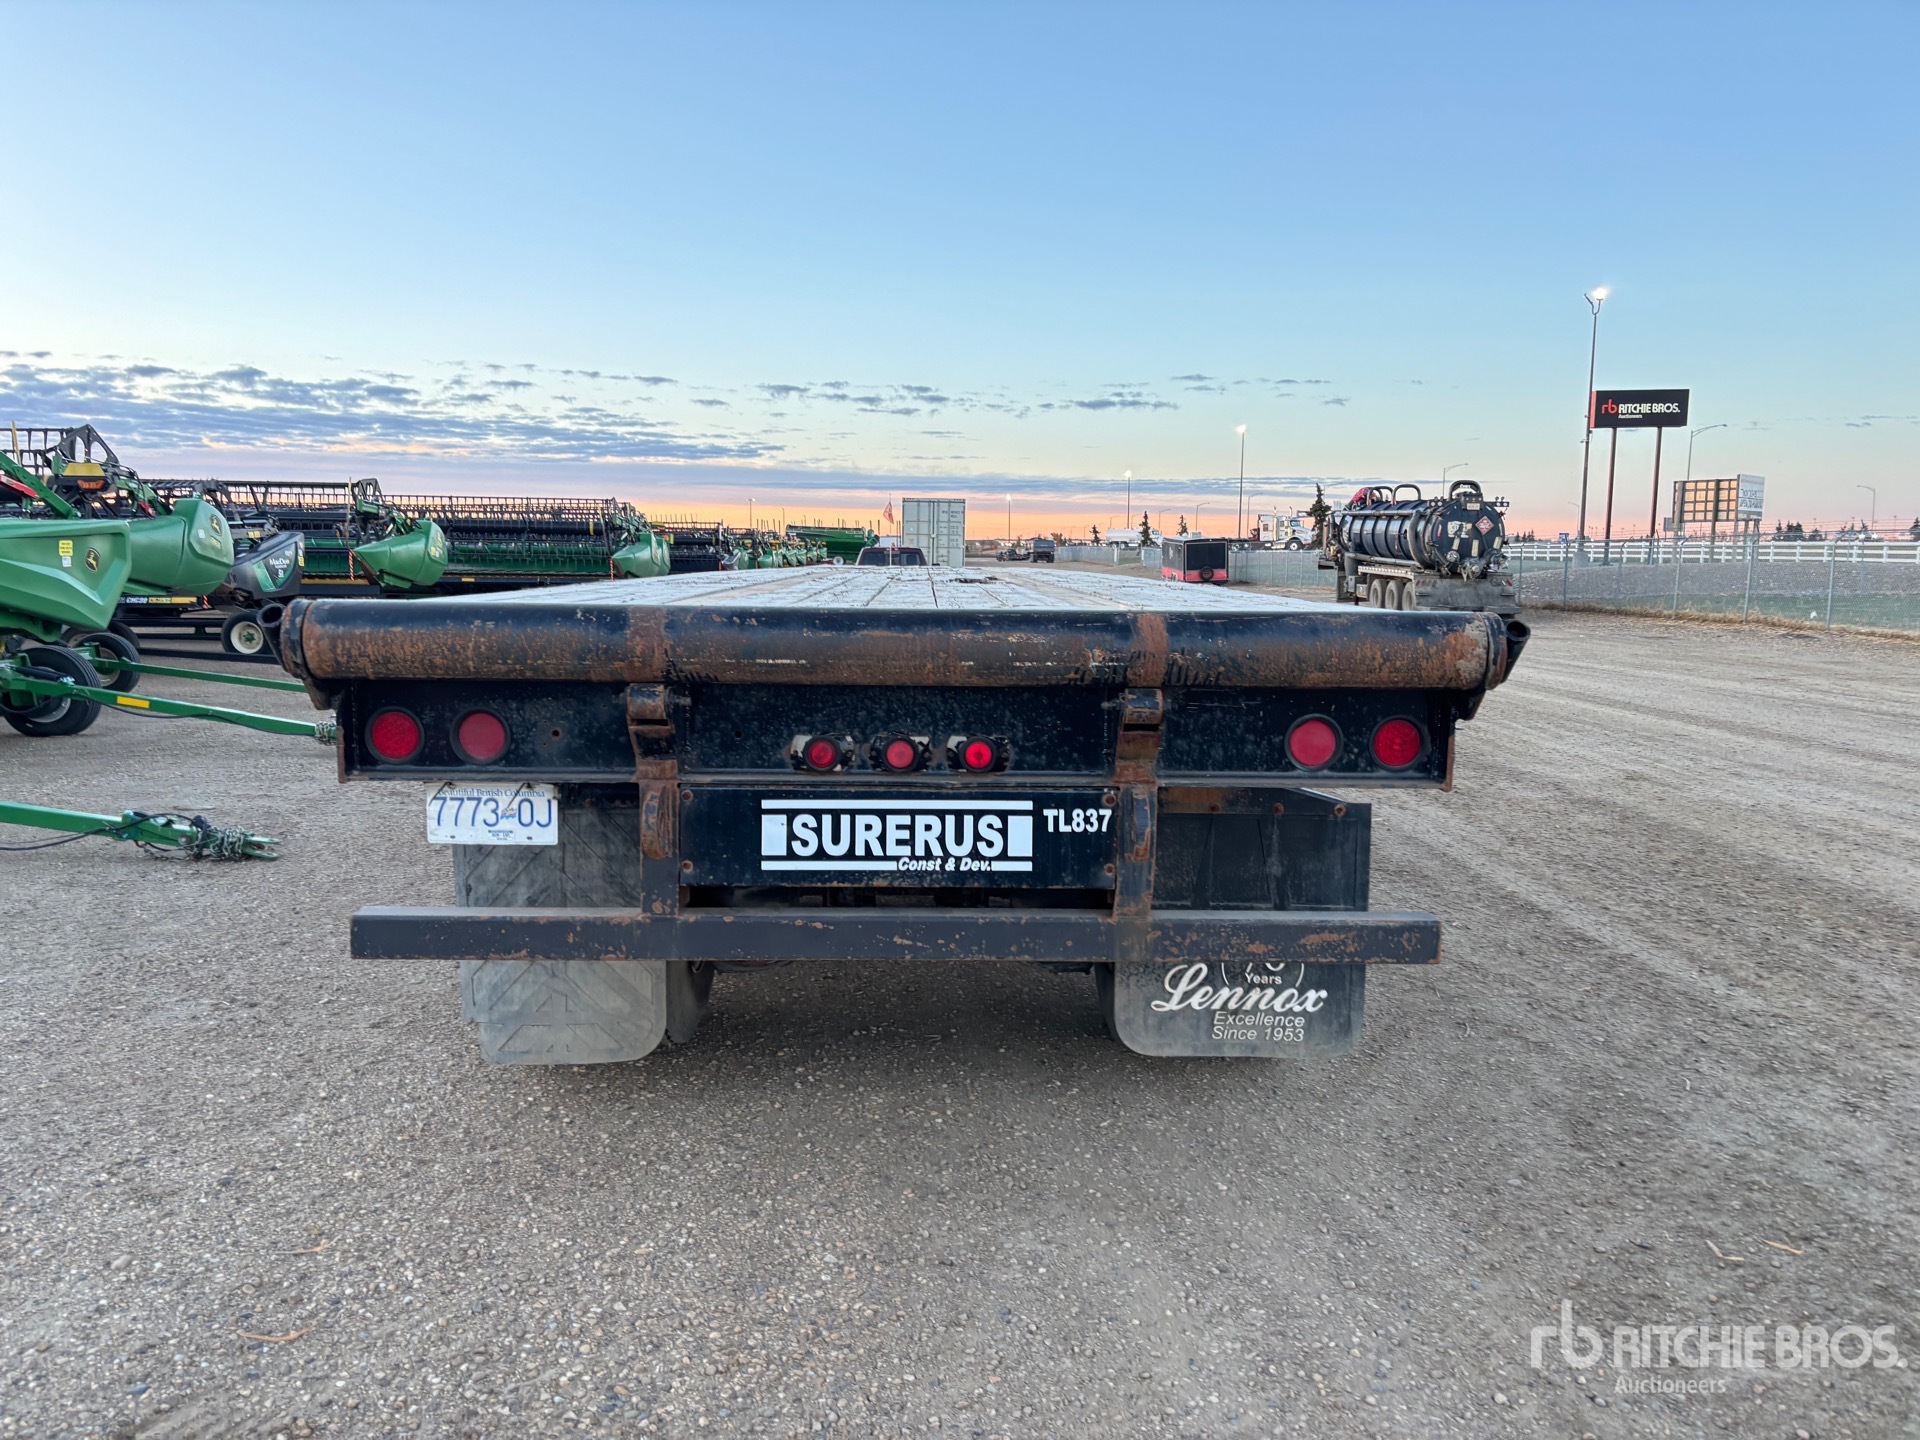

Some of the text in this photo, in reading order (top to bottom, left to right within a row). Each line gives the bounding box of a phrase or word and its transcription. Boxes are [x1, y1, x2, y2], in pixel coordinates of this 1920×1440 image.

[1618, 403, 1651, 414] RITCHIE
[1652, 403, 1680, 413] BROS.
[476, 788, 503, 797] British
[433, 796, 500, 828] 7773
[1043, 808, 1112, 833] TL837
[791, 814, 1004, 857] SURERUS
[898, 857, 991, 872] Const & Dev.
[1245, 971, 1282, 985] Years
[1151, 963, 1328, 1012] Lennox
[1213, 1011, 1305, 1027] Excellence
[1211, 1026, 1305, 1042] Since 1953
